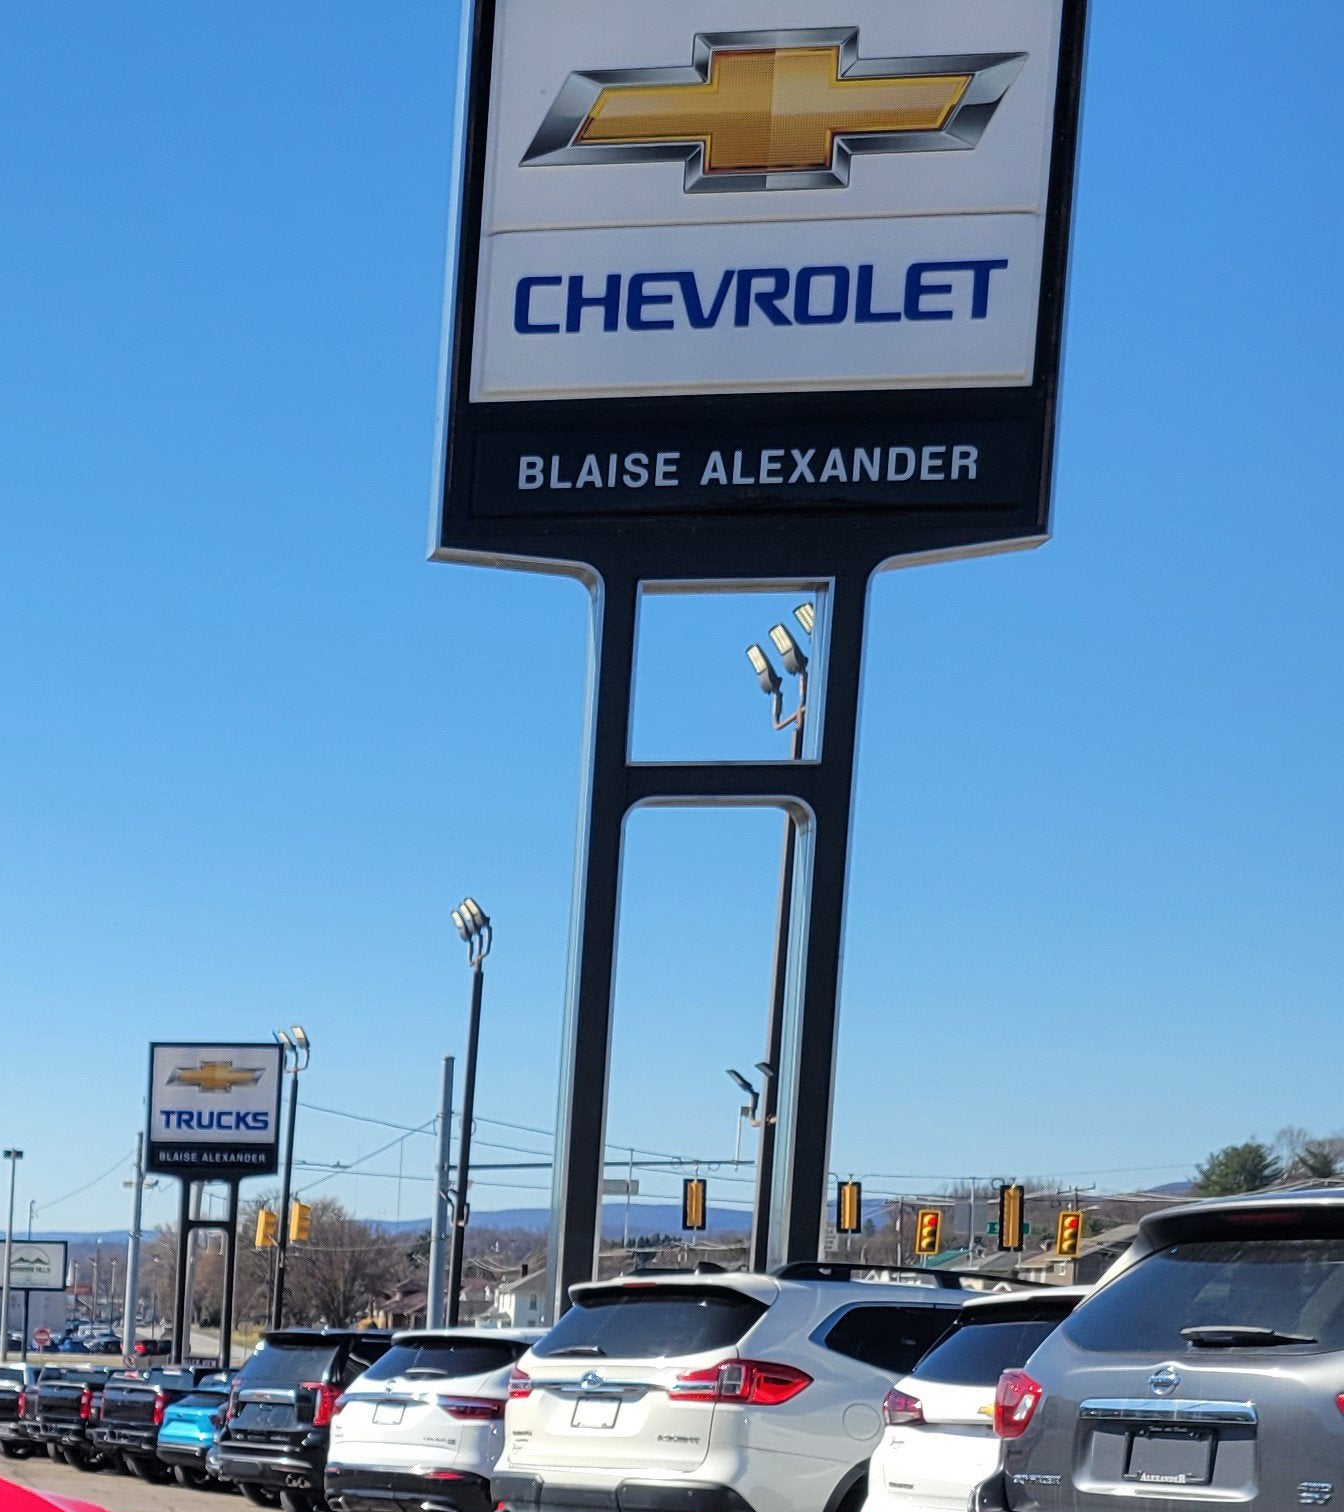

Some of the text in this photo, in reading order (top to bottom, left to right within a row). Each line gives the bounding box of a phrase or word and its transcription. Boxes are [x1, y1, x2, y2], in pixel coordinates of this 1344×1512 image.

[513, 259, 1008, 334] CHEVROLET
[517, 445, 979, 490] BLAISE ALEXANDER
[160, 1109, 269, 1131] TRUCKS
[159, 1151, 266, 1163] BLAISE ALEXANDER
